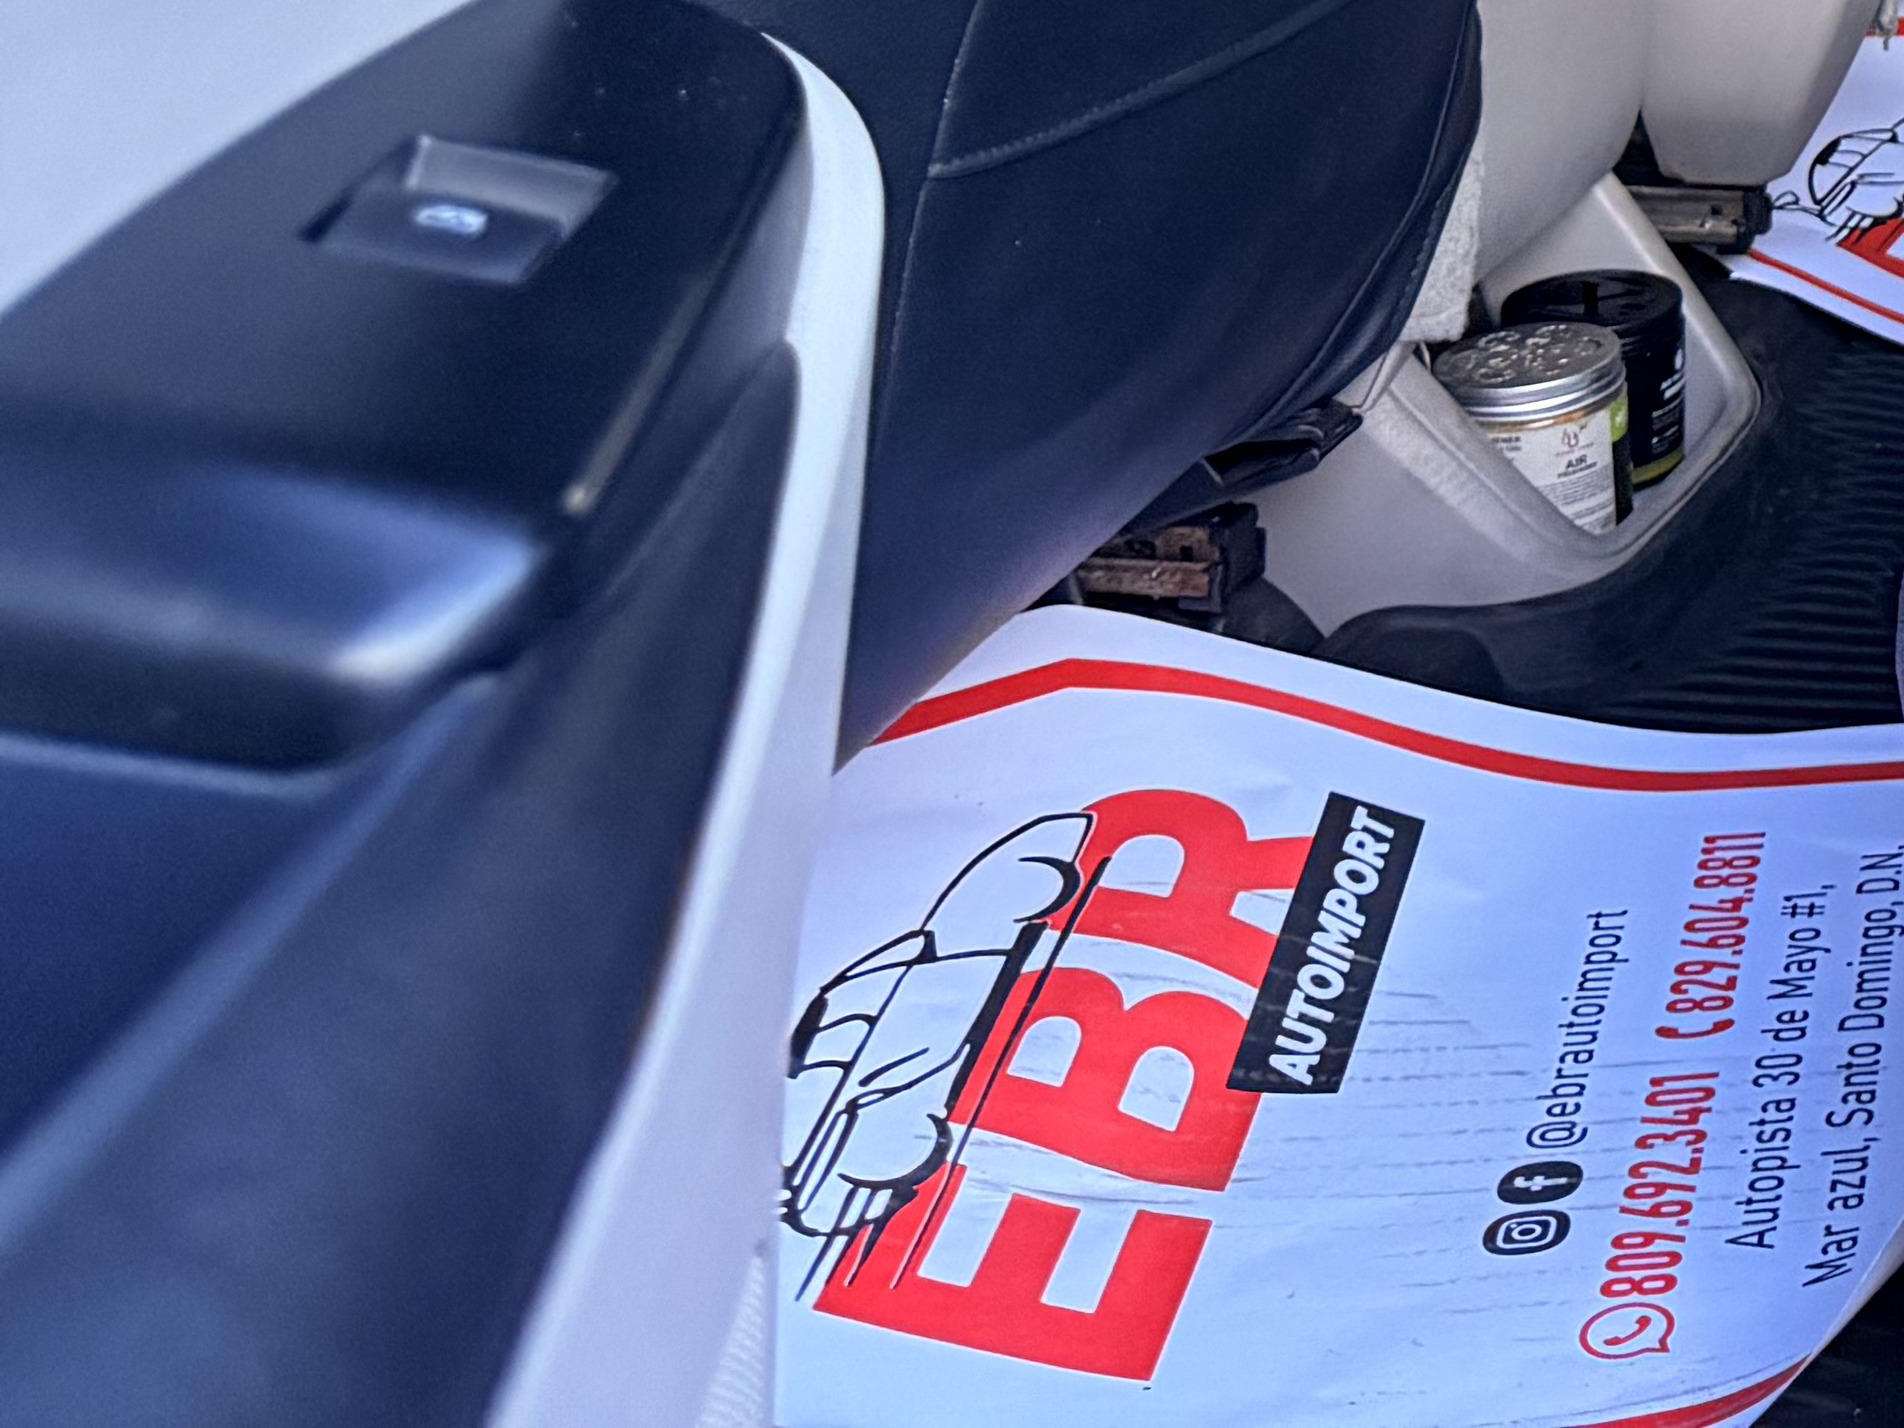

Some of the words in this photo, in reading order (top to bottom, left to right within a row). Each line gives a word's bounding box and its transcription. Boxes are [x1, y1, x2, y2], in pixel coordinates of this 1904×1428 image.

[1781, 884, 1837, 918] #1,
[1855, 844, 1904, 896] D.N.
[1268, 805, 1396, 1086] AUTOIMPORT
[1766, 927, 1832, 1000] Mayo
[1525, 909, 1629, 1149] @ebrautoimport
[1760, 1009, 1810, 1043] de
[812, 789, 1317, 1381] EBR
[1600, 1072, 1720, 1298] 809.692.3401
[1665, 831, 1767, 1015] 829.604.8811
[1752, 1052, 1803, 1089] 30
[1824, 1040, 1882, 1129] Santo
[1725, 1094, 1800, 1249] Autopista
[1821, 1135, 1880, 1211] azul,
[1802, 1224, 1859, 1288] Mar
